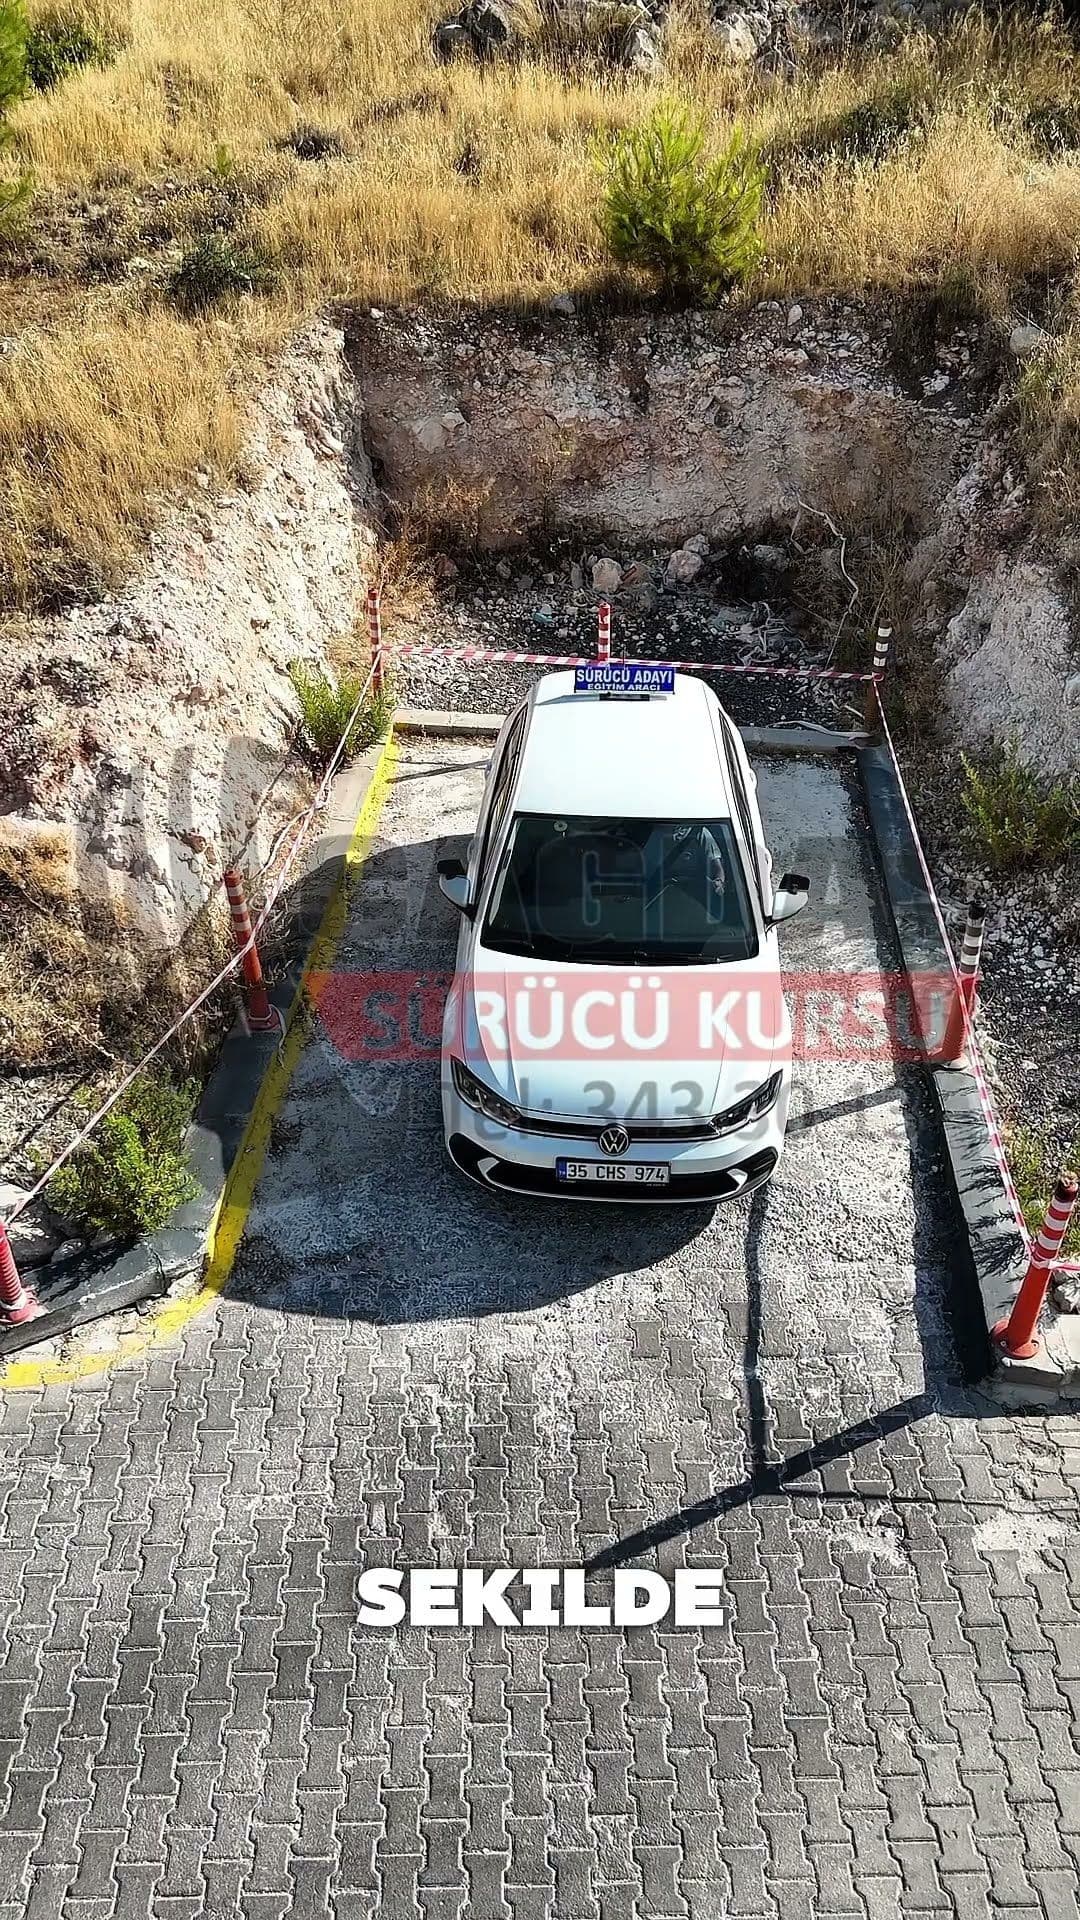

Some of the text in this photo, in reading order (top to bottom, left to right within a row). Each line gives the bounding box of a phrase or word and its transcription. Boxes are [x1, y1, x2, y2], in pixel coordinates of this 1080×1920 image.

[576, 666, 672, 684] SÜRÜCÜ ADAYI
[567, 1165, 665, 1181] 35 CHS 974
